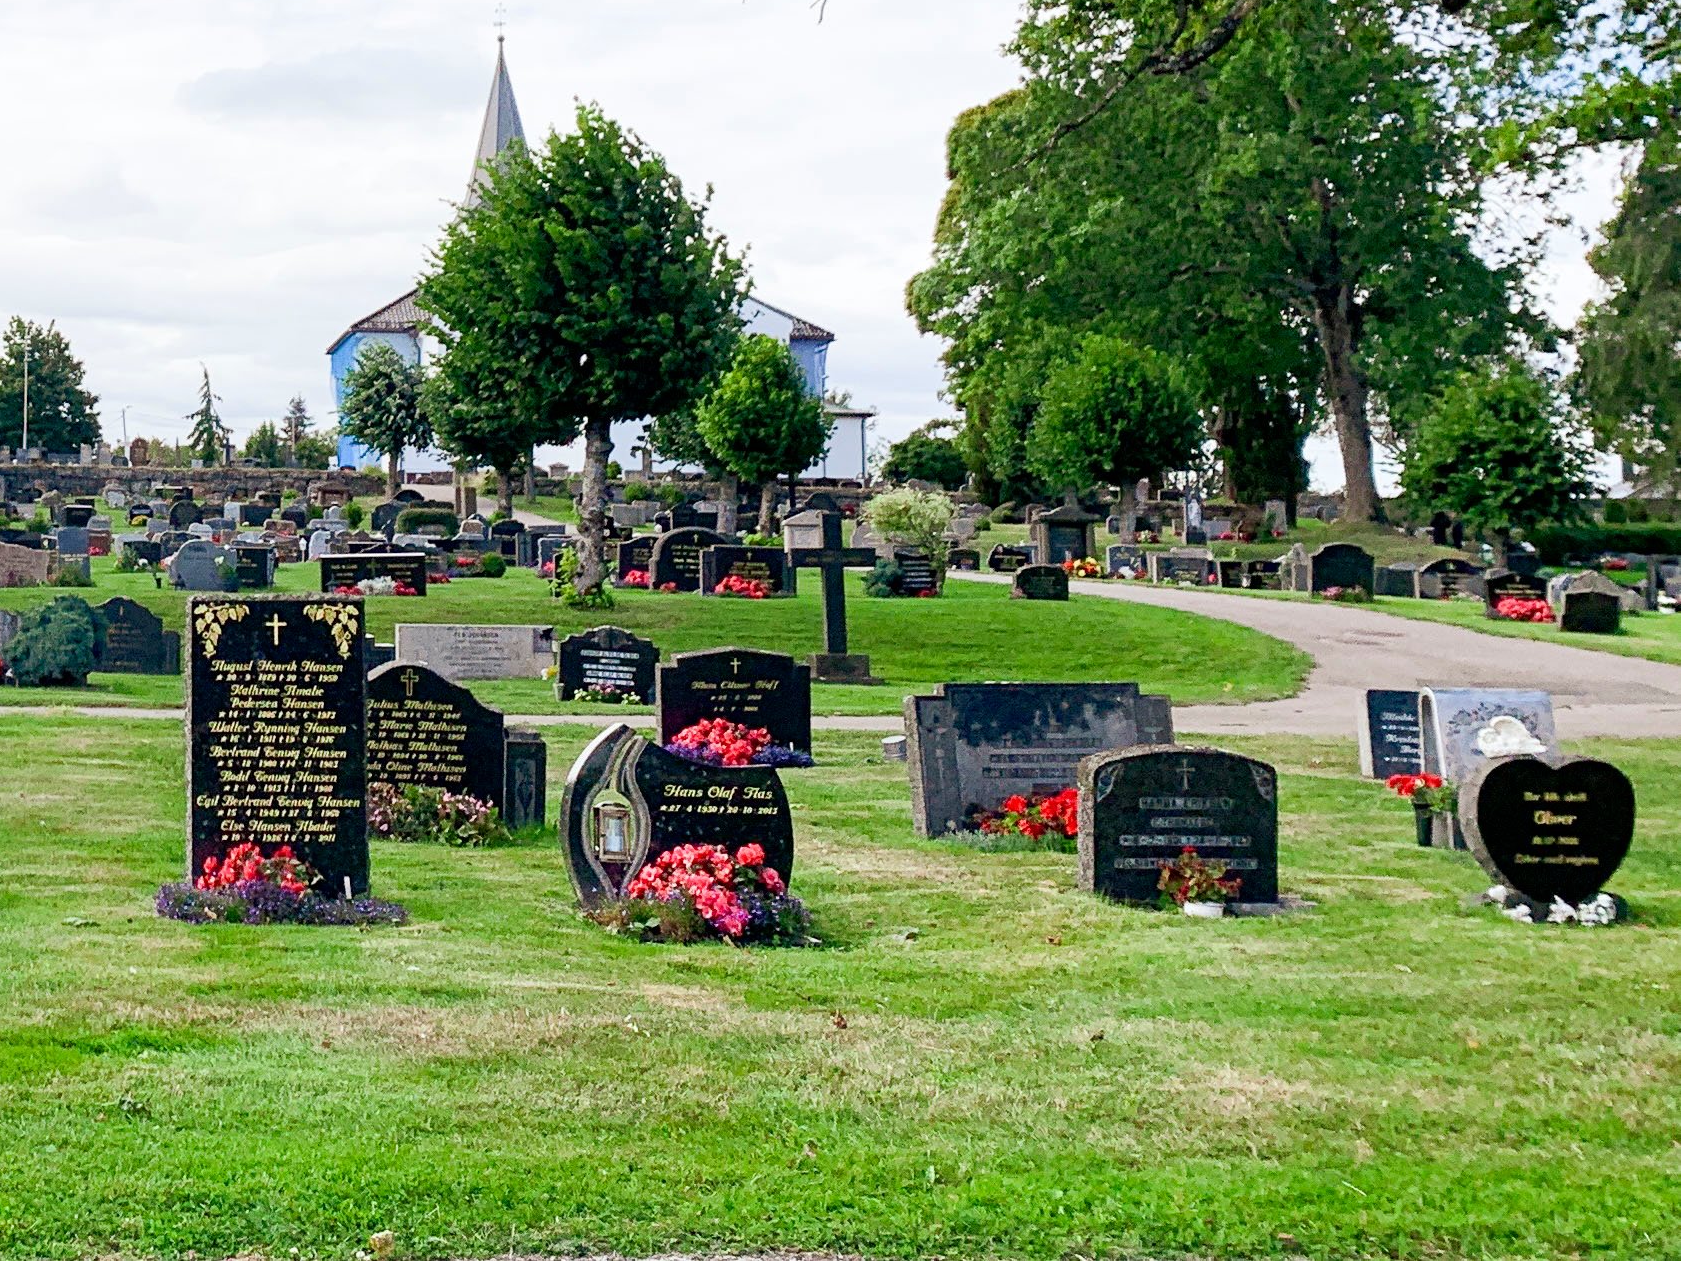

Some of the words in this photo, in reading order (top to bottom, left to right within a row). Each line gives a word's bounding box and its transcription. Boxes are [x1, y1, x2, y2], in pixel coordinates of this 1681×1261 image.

[256, 660, 297, 672] Henrik
[300, 661, 343, 672] Hansen
[281, 697, 324, 708] Hansen
[304, 721, 346, 733] Hansen
[304, 746, 346, 758] Hansen
[293, 771, 337, 782] Hansen
[664, 784, 703, 797] Hans
[708, 786, 738, 800] Olaf
[317, 796, 360, 808] Hansen
[248, 820, 291, 832] Hansen
